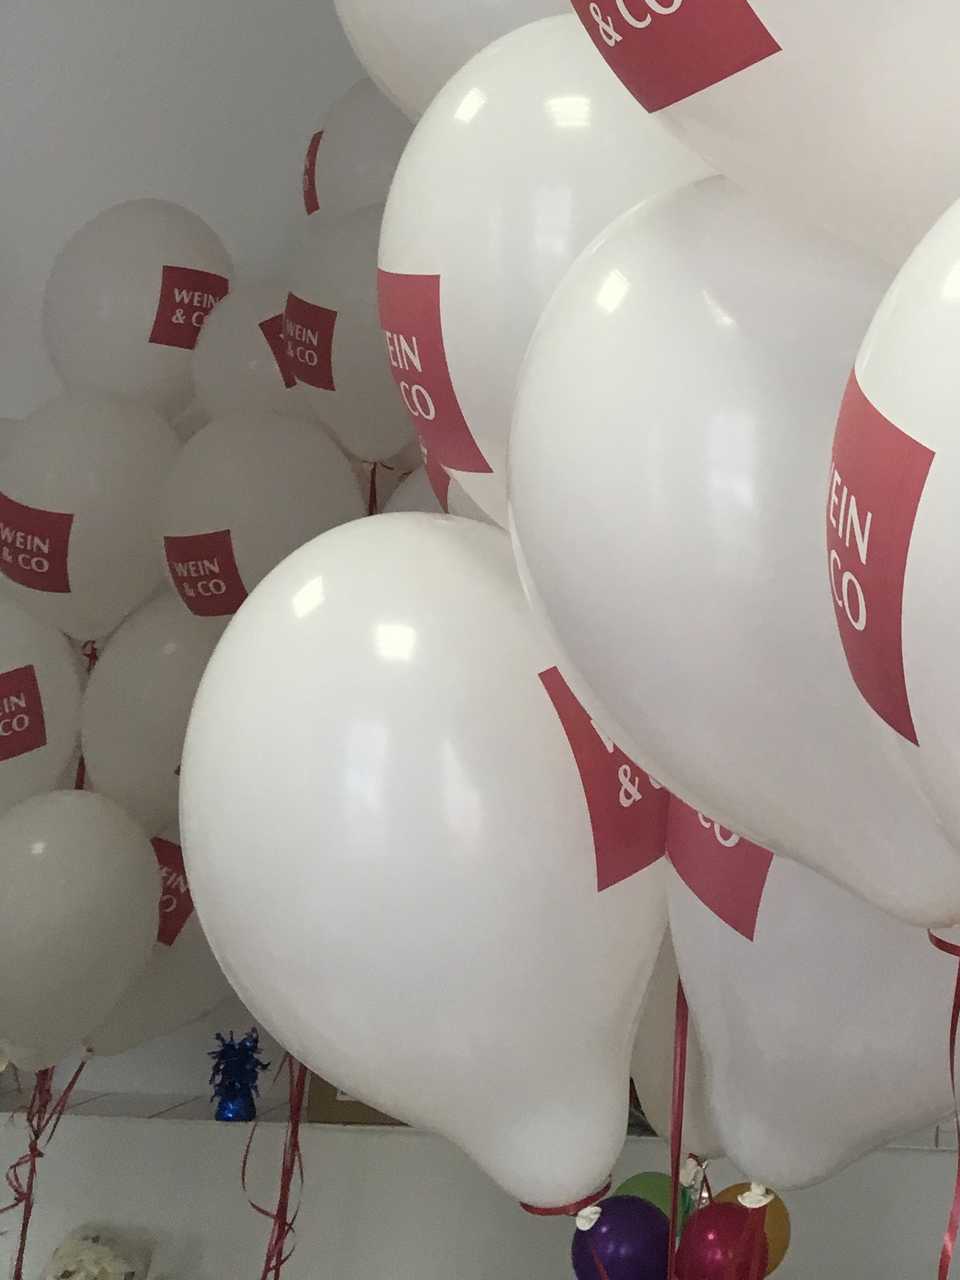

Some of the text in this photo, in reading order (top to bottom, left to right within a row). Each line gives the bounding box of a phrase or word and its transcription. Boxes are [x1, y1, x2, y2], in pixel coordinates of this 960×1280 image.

[589, 2, 623, 47] &
[171, 308, 186, 324] &
[296, 346, 318, 366] CO
[385, 328, 422, 372] EIN
[400, 381, 435, 420] CO
[830, 463, 872, 565] EIN
[0, 523, 49, 554] WEIN
[18, 554, 49, 572] CO
[174, 558, 220, 577] WEIN
[198, 579, 226, 596] CO
[830, 549, 867, 631] CO
[617, 764, 642, 807] &
